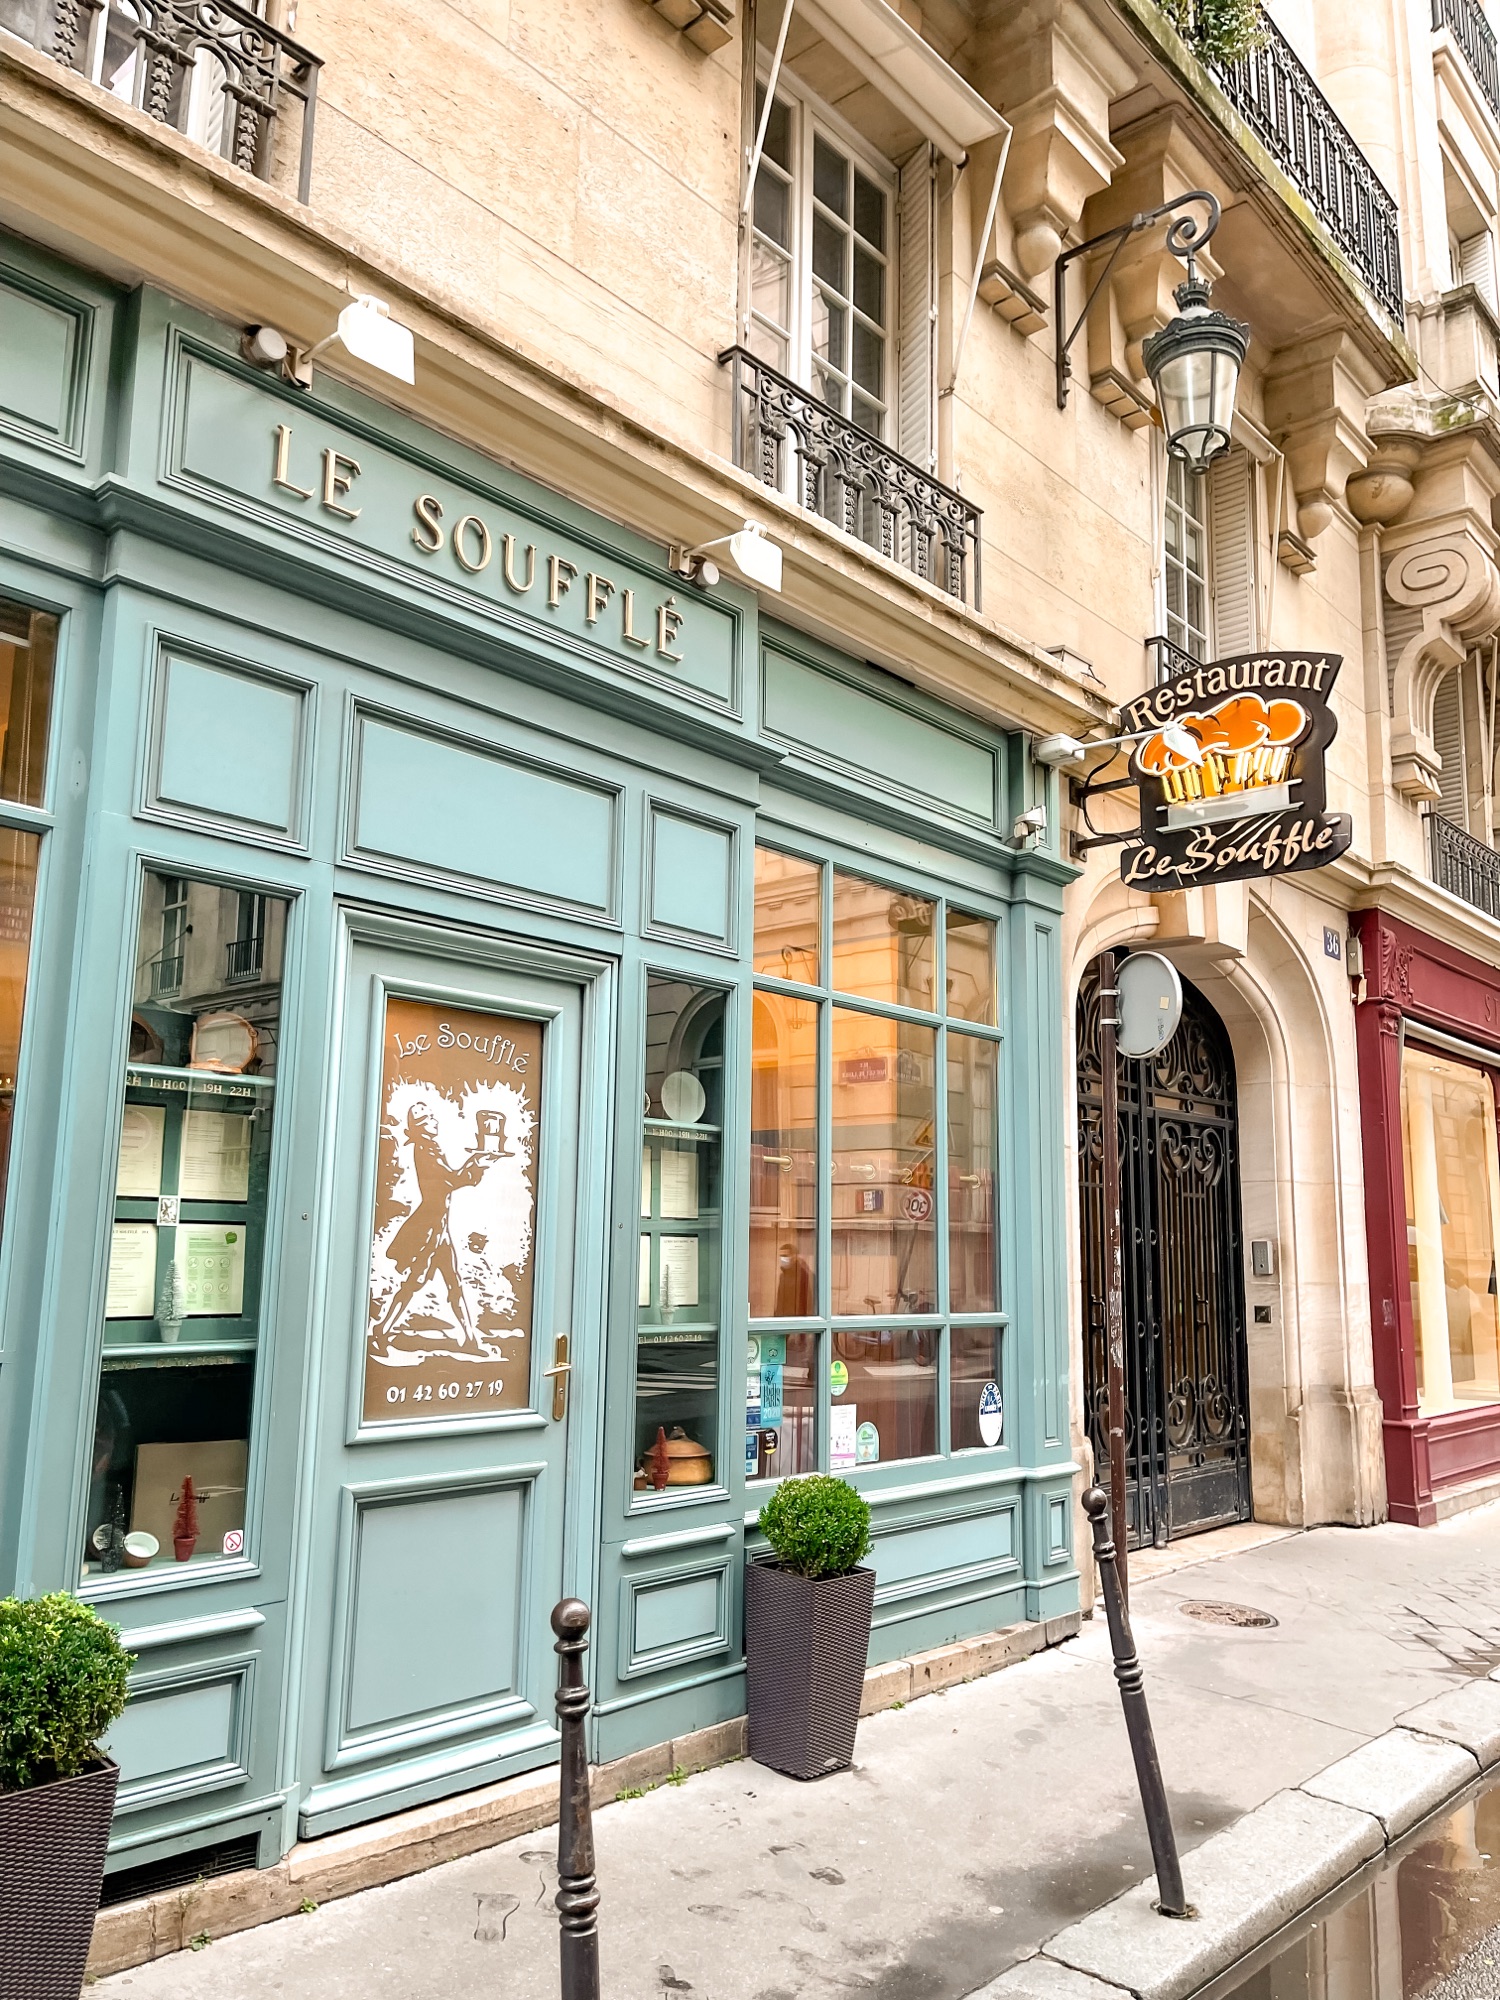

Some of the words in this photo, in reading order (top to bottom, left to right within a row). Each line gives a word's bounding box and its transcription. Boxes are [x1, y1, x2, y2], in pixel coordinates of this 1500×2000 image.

[273, 423, 363, 520] LE
[412, 494, 685, 662] SOUFFLÉ
[1127, 656, 1331, 733] Restaurant
[1124, 844, 1176, 885] Le
[1178, 816, 1342, 876] Soufflé
[1326, 931, 1339, 955] 36
[393, 1033, 431, 1058] Le
[437, 1023, 530, 1073] Soufflé
[203, 1083, 222, 1095] 19H
[229, 1086, 251, 1097] 22H
[386, 1386, 406, 1403] 01
[412, 1384, 433, 1402] 42
[438, 1382, 460, 1400] 60
[465, 1380, 484, 1398] 27
[488, 1379, 504, 1396] 19
[763, 1408, 781, 1419] 2020
